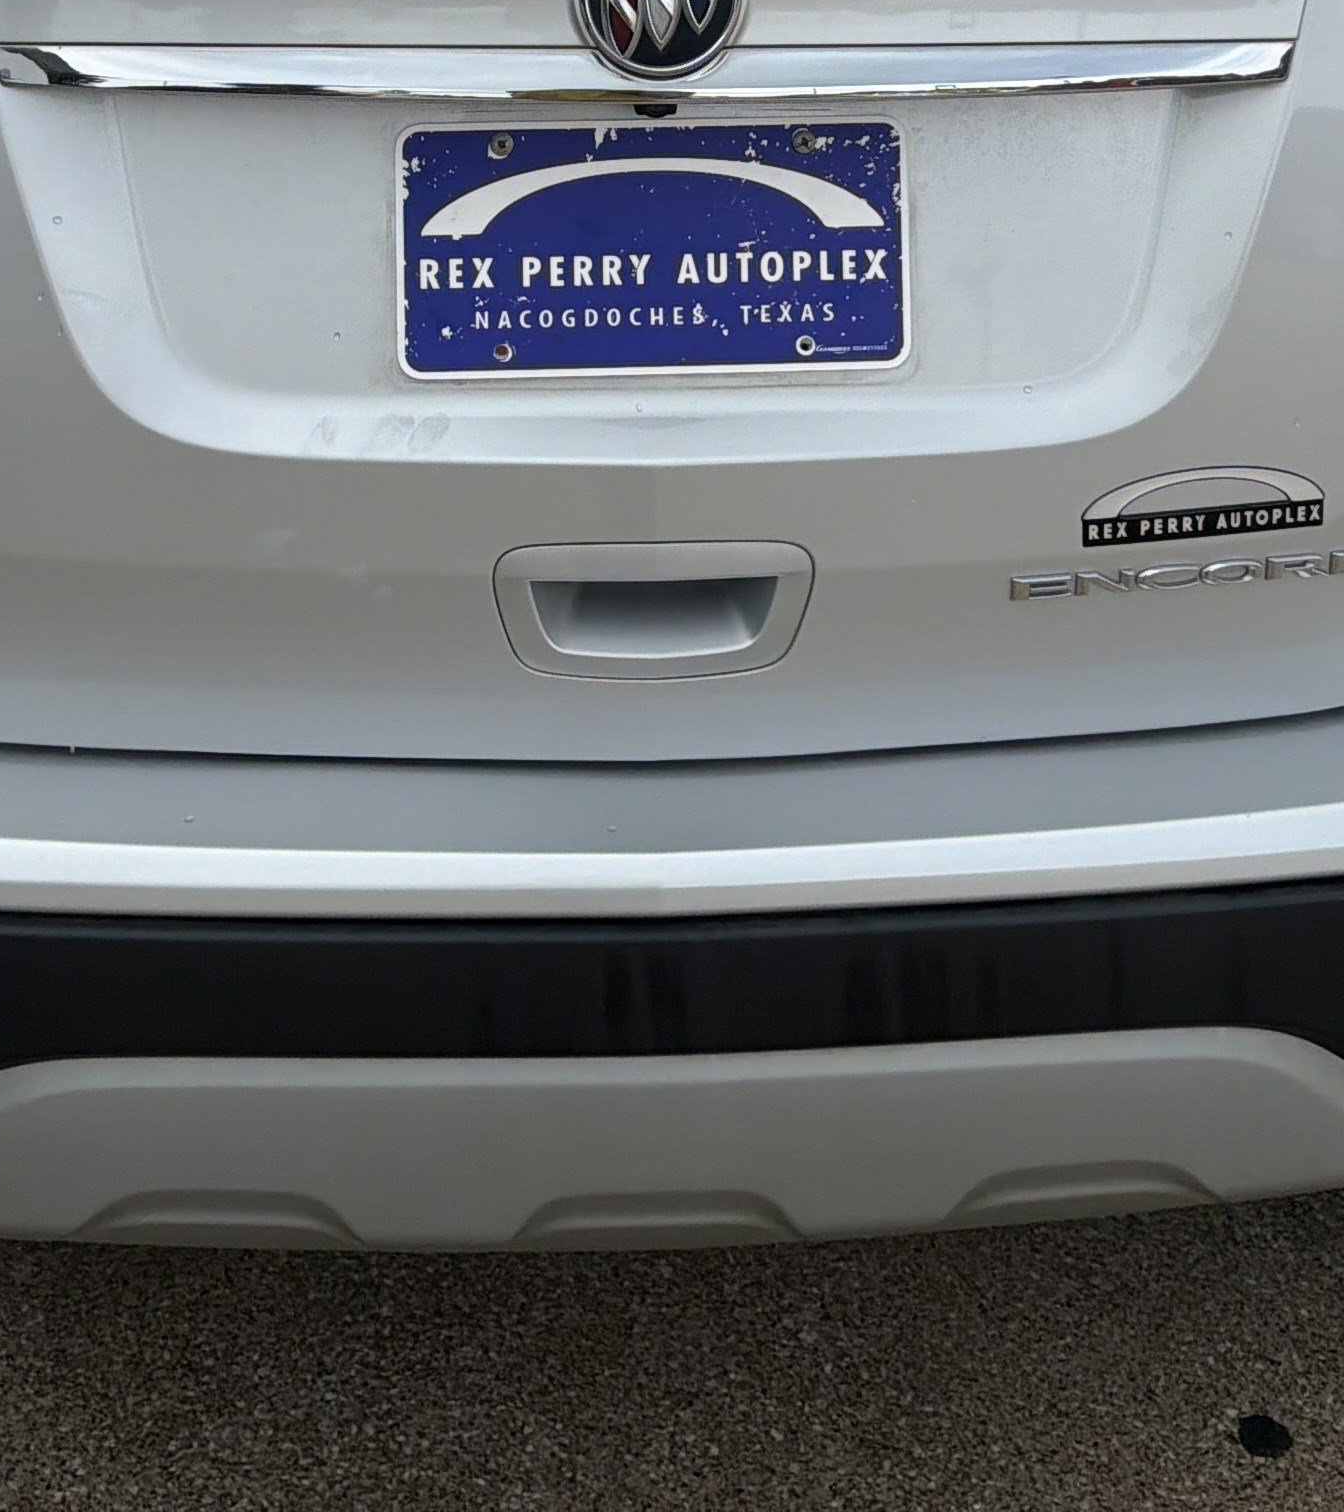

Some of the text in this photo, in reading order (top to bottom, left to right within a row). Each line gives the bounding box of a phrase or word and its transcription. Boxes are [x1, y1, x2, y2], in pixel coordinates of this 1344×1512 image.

[418, 249, 887, 290] REX PERRY AUTOPLEX
[740, 303, 835, 324] TEXAS
[1088, 504, 1321, 541] REX PERRY AUTOPLEX
